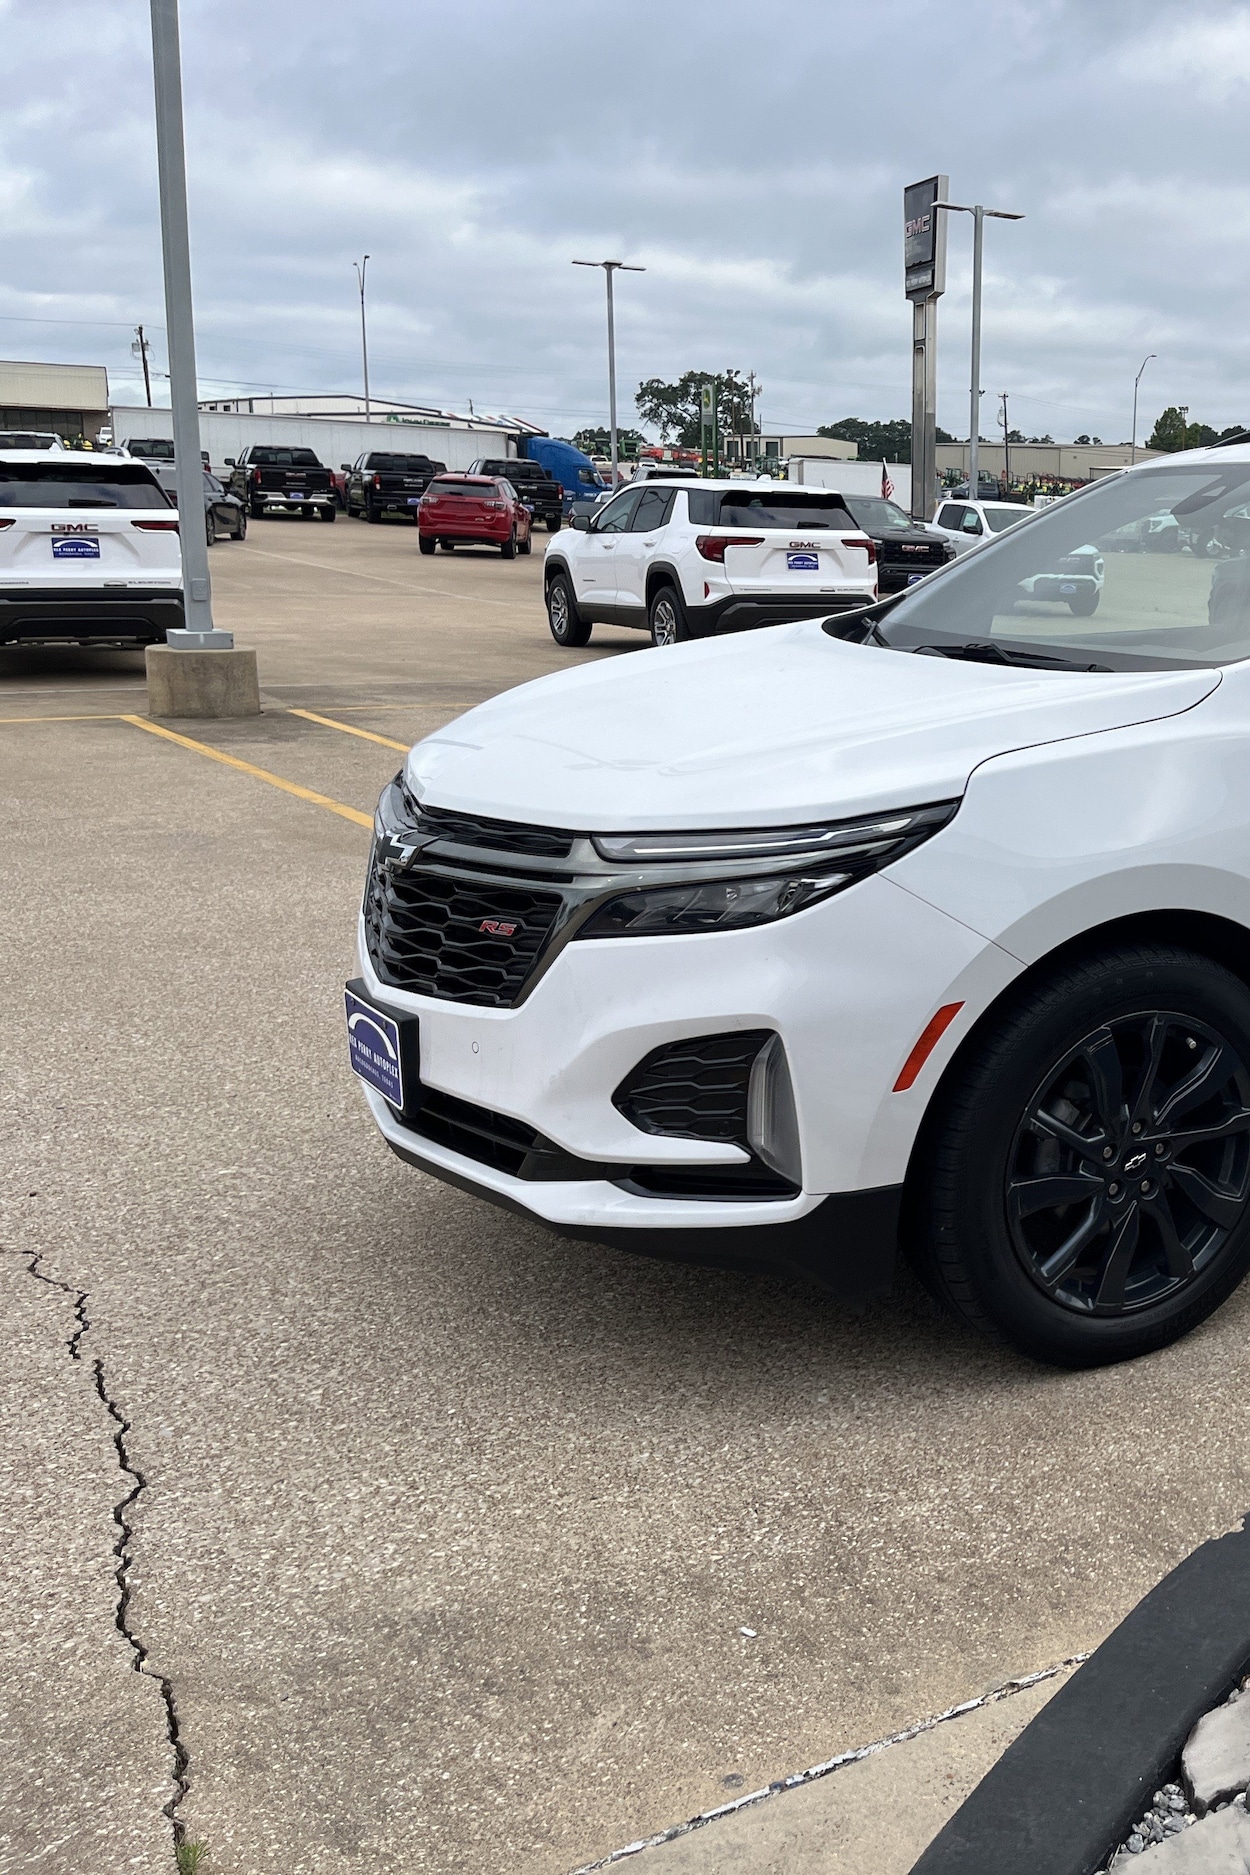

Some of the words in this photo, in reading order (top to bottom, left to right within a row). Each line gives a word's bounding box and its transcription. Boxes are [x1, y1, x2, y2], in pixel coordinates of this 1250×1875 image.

[905, 214, 931, 238] GMC
[51, 523, 99, 532] GMC
[789, 541, 821, 549] GMC
[478, 919, 518, 937] RS
[357, 1040, 373, 1060] PERRY
[373, 1052, 399, 1080] AUTOPLEX
